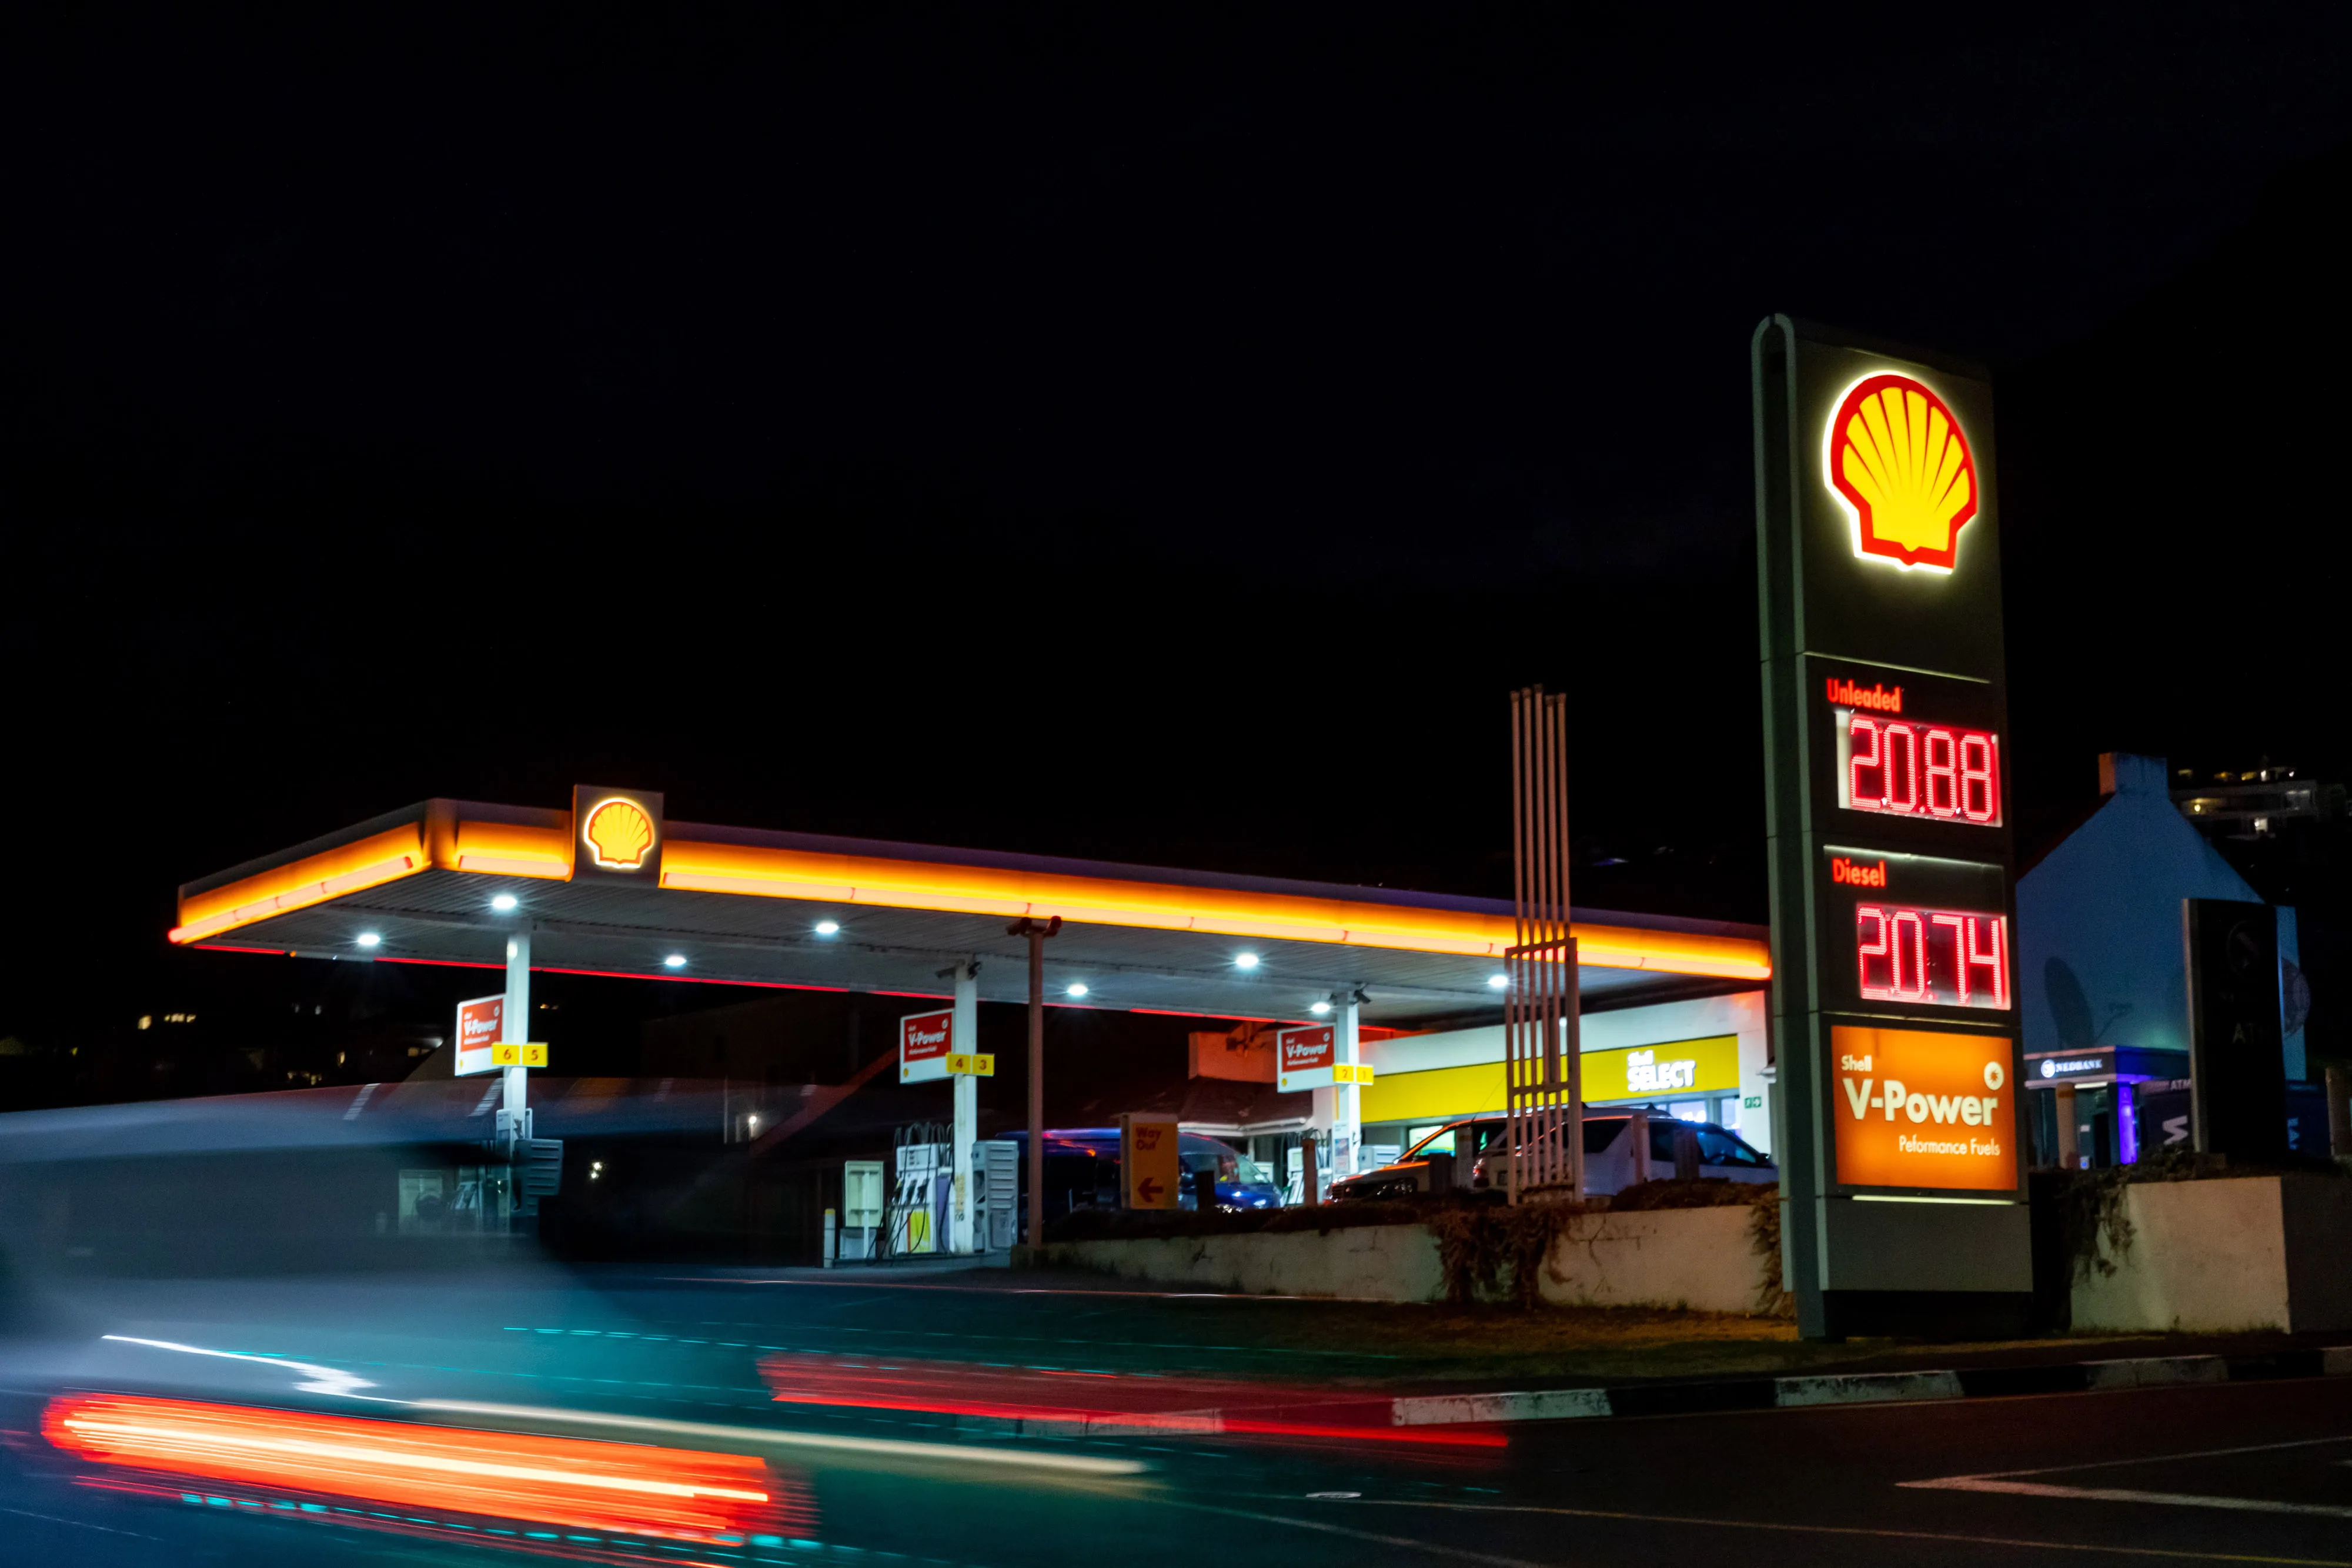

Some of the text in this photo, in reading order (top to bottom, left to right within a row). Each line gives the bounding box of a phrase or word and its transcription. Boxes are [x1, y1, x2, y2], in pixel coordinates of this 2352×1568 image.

[1826, 678, 1901, 712] Unleaded
[1850, 718, 1994, 821] 20.88
[1832, 857, 1886, 887] Diesel
[1857, 906, 2002, 1007] 20.74
[908, 1031, 946, 1047] V-Power
[503, 1048, 512, 1061] 6
[530, 1049, 539, 1061] 5
[1286, 1042, 1328, 1058] V-Power
[956, 1058, 964, 1069] 4
[979, 1059, 987, 1071] 3
[1841, 1054, 1872, 1072] Shell
[2056, 1059, 2103, 1073] NEDBANK
[1628, 1060, 1696, 1092] SELECT
[1843, 1078, 1999, 1126] V-Power
[1970, 1138, 2000, 1156] Fuels
